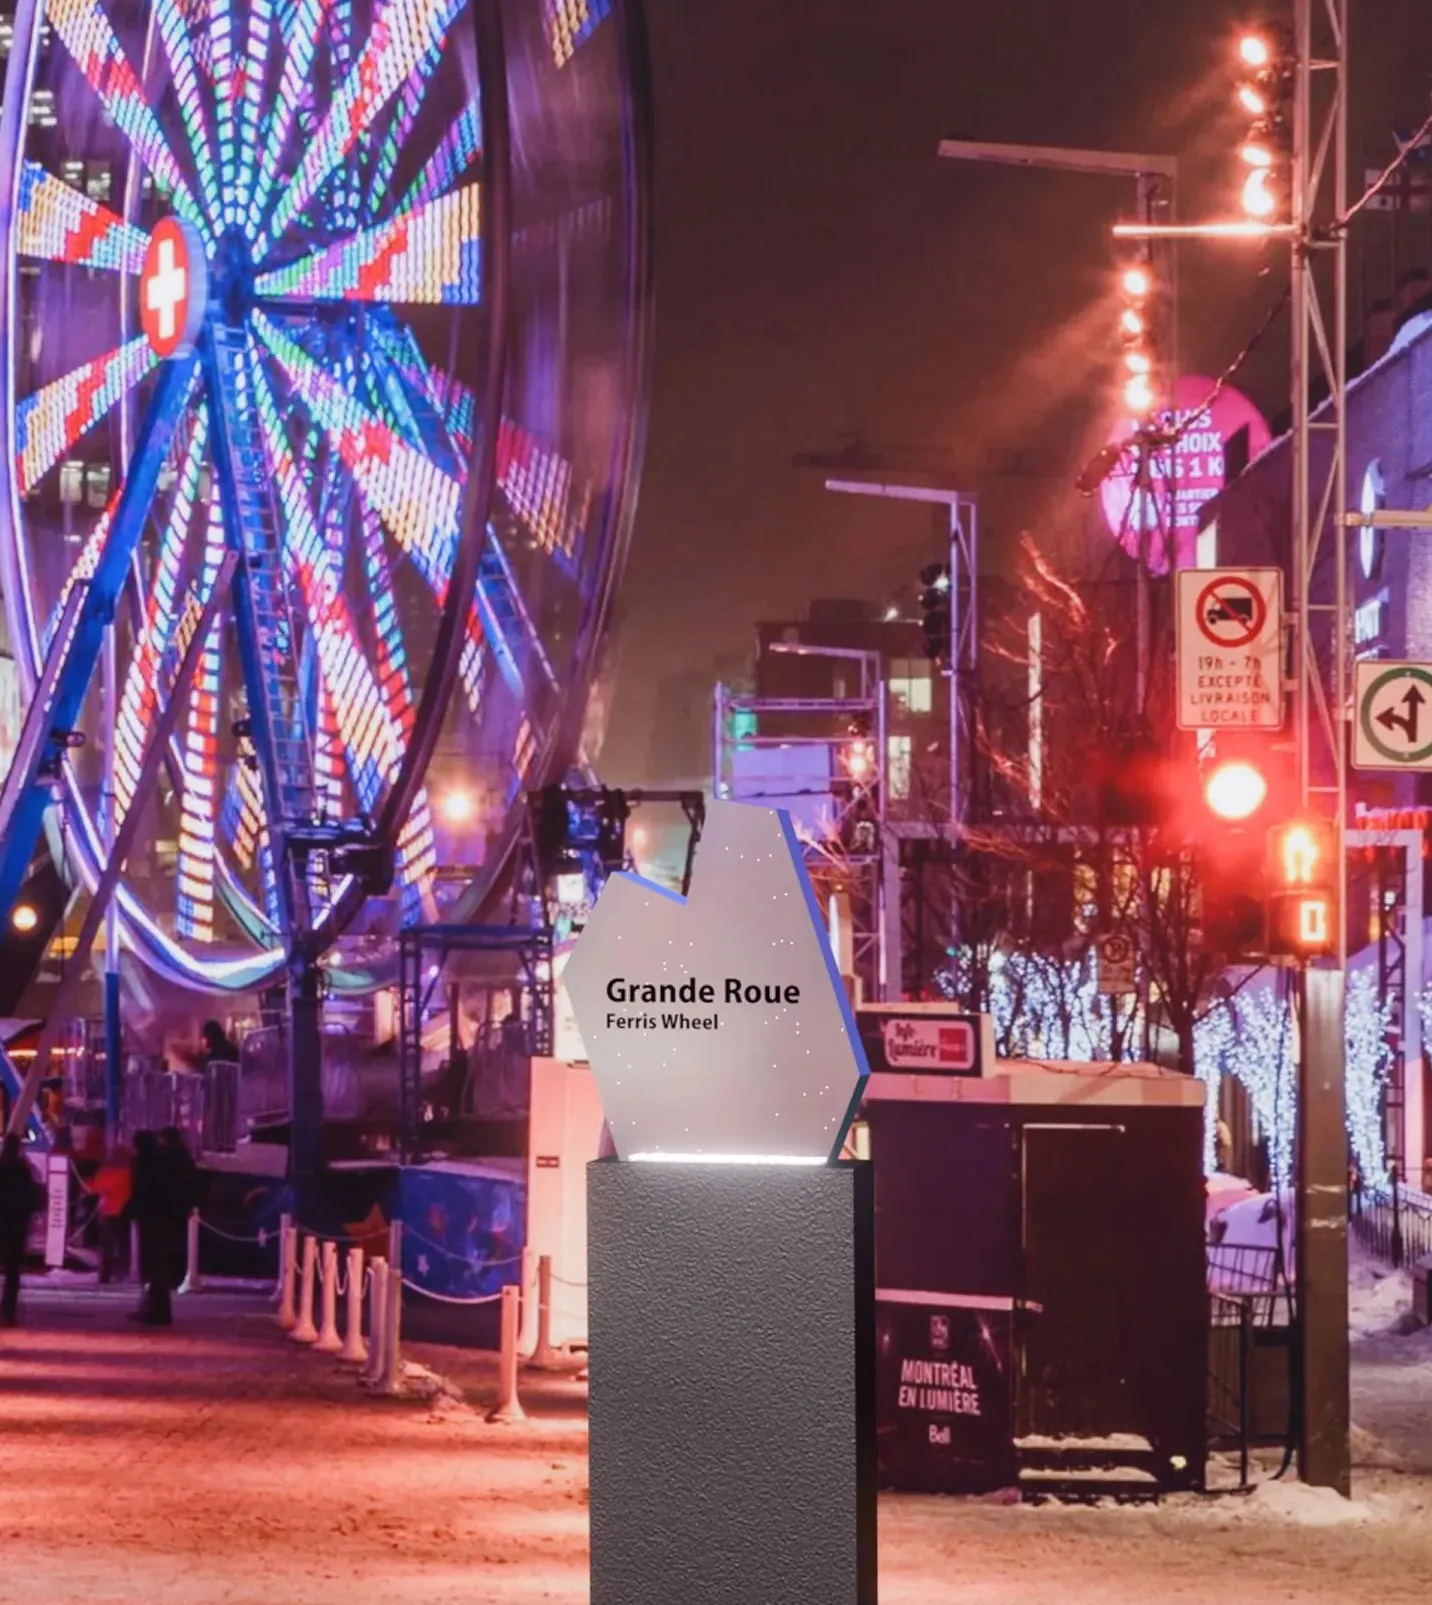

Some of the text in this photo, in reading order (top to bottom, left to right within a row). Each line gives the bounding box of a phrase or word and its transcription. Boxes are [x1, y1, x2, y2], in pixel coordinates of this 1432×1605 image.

[1198, 656, 1223, 670] 19h
[1244, 656, 1261, 671] 7h
[1198, 672, 1261, 689] EXCEPTÉ
[1190, 691, 1271, 705] LIVRAISON
[1201, 710, 1258, 722] LOCALE
[606, 977, 801, 1004] Grande Roue
[606, 1013, 718, 1029] Ferris Wheel
[901, 1359, 977, 1390] MONTRÉAL
[898, 1385, 981, 1415] EN LUMIÈRE
[929, 1424, 951, 1443] Bell
